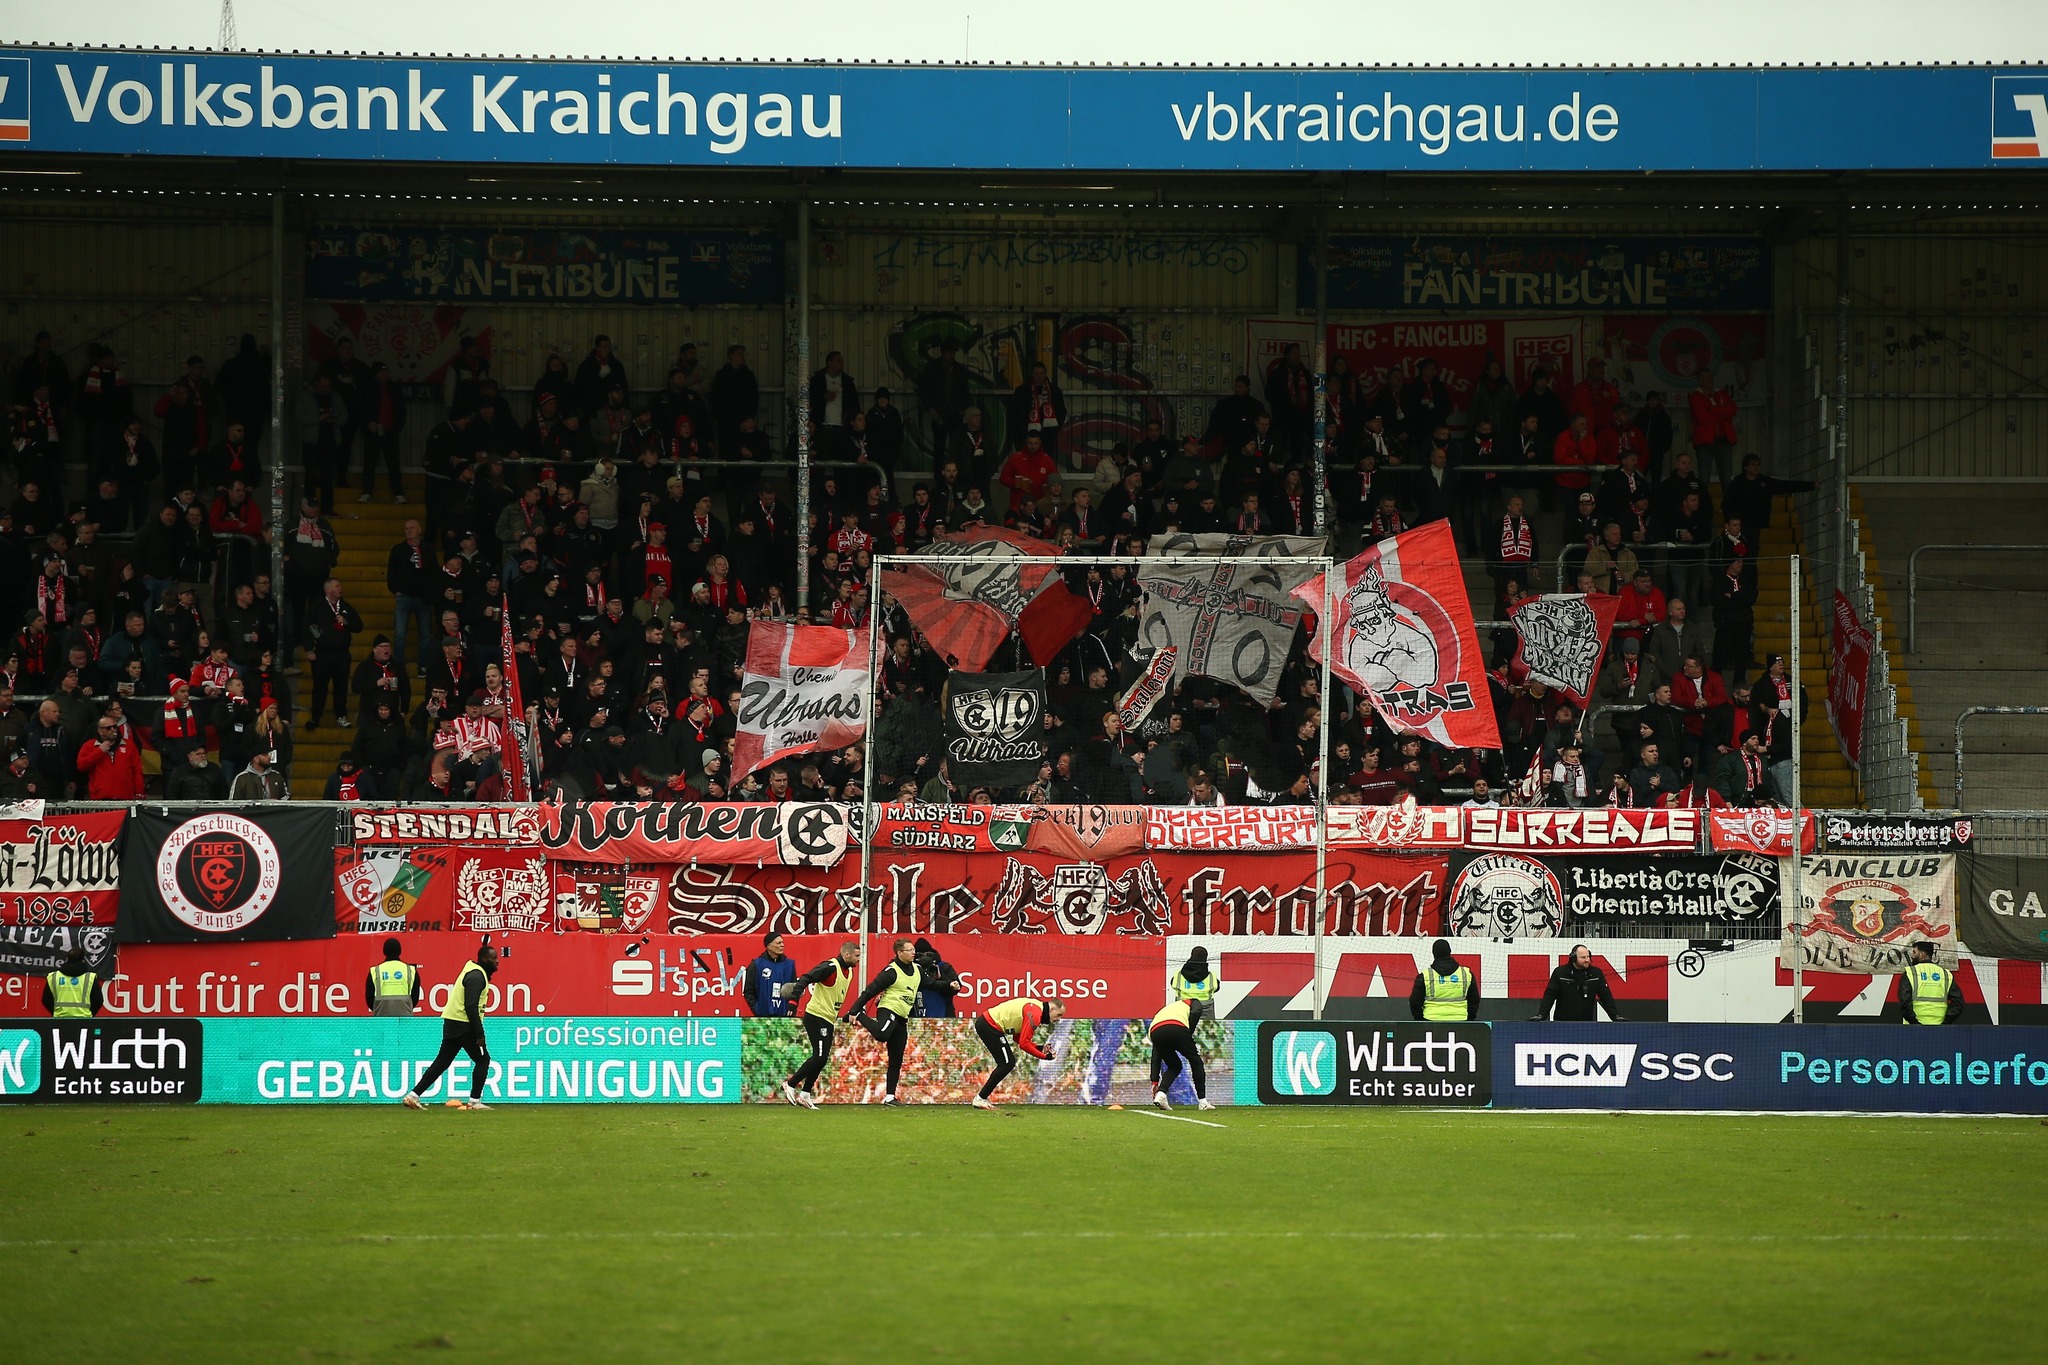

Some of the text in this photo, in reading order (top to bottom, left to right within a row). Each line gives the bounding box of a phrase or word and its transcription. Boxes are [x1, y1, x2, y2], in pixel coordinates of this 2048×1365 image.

[55, 63, 843, 154] Volksbank Kraichgau
[1171, 91, 1620, 155] vbkraichgau.de
[1336, 328, 1377, 350] HFC
[1393, 323, 1488, 348] FANCLUB
[1517, 338, 1571, 356] HFC
[959, 693, 984, 707] HFC
[999, 691, 1032, 737] 19
[354, 812, 519, 840] STENDAL
[887, 806, 985, 825] MANSFELD
[169, 816, 264, 848] Merseburger
[891, 826, 976, 850] SÜDHARZ
[1471, 810, 1697, 846] SURREALE
[1827, 817, 1952, 846] Petersberg
[200, 843, 235, 856] HFC
[162, 862, 172, 875] 19
[264, 860, 275, 873] 19
[343, 865, 368, 883] HFC
[474, 871, 498, 881] HFC
[512, 872, 529, 882] FC
[1062, 869, 1099, 885] HFC
[1467, 854, 1548, 879] Ultras
[1737, 853, 1775, 877] HFC
[1801, 857, 1941, 878] FANCLUB
[162, 879, 175, 891] 66
[262, 876, 275, 889] 66
[506, 881, 533, 892] RWE
[626, 879, 653, 890] HFC
[1571, 865, 1664, 891] Libertà
[668, 860, 985, 935] Saale
[1183, 866, 1438, 936] front
[1496, 889, 1519, 898] HFC
[1571, 893, 1728, 917] Chemie Halle
[1919, 895, 1942, 910] 84
[14, 895, 94, 926] 1984
[193, 911, 244, 929] Jungs
[101, 973, 184, 1014] Gut
[196, 972, 265, 1013] für
[279, 972, 350, 1013] die
[957, 971, 1109, 1004] Sparkasse
[515, 1018, 718, 1055] professionelle
[52, 1028, 187, 1070] Wirth
[1347, 1031, 1477, 1073] Wirth
[257, 1048, 724, 1099] GEBÄUDEREINIGUNG
[1527, 1053, 1735, 1082] HCM SSC
[55, 1076, 185, 1094] Echt sauber
[1349, 1077, 1476, 1099] Echt sauber
